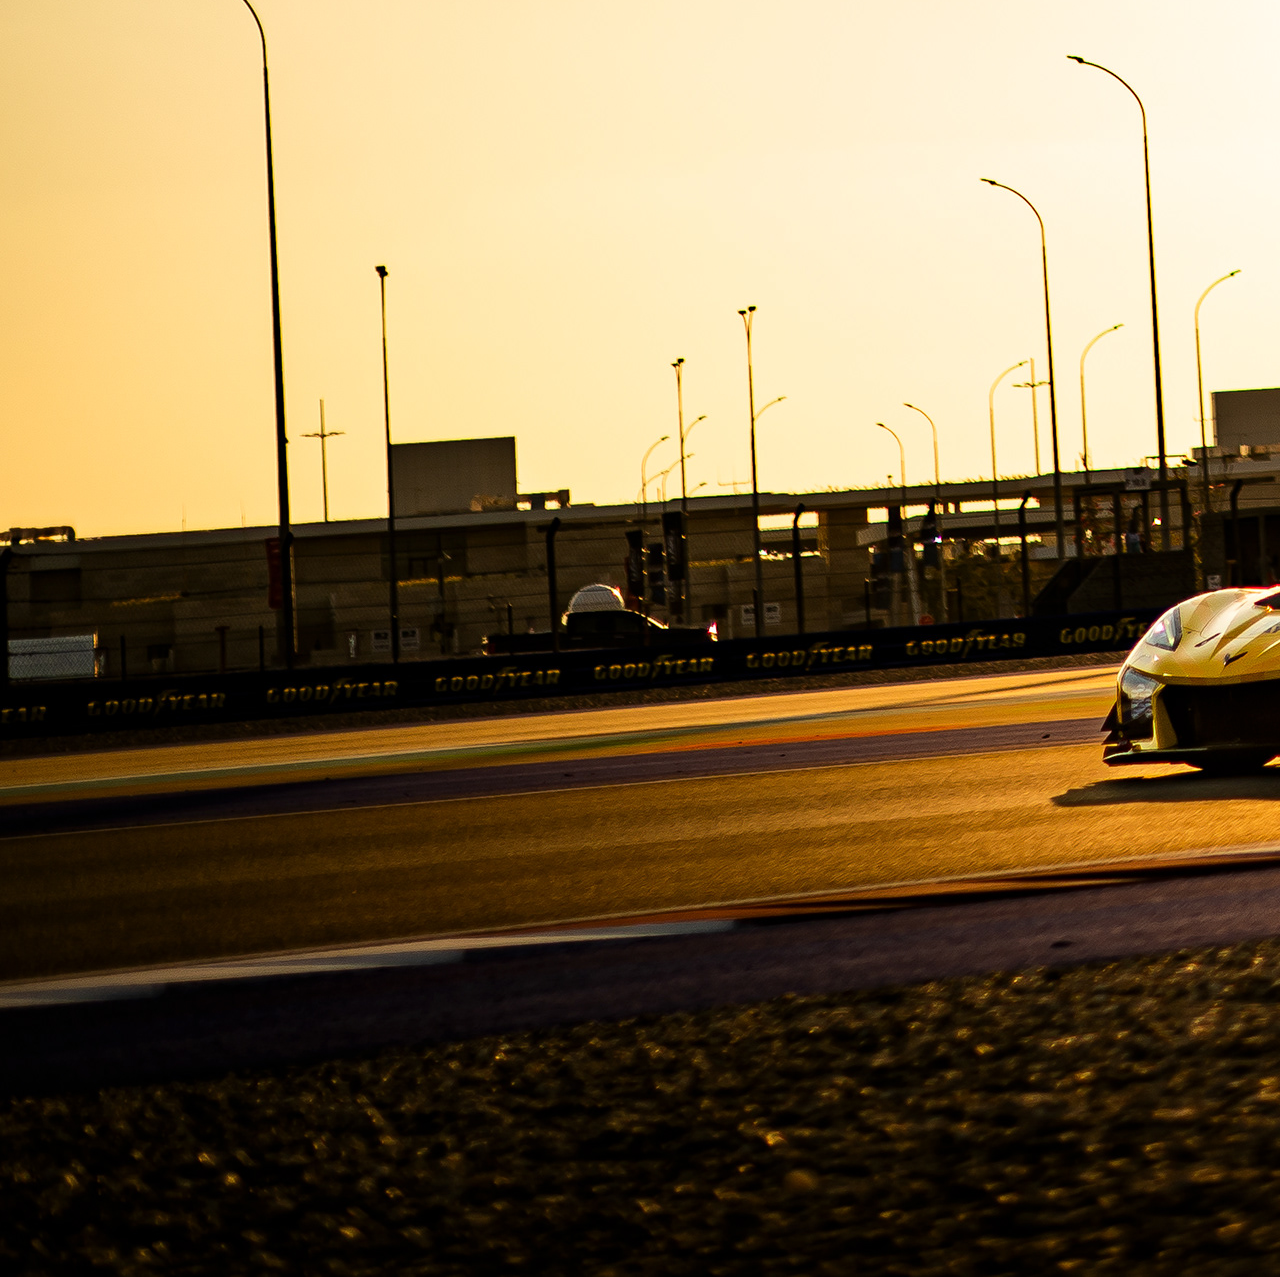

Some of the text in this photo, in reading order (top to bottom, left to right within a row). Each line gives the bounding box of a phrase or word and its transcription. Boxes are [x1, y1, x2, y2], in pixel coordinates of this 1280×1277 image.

[905, 629, 1027, 659] GOODYEAR
[1058, 617, 1149, 645] GOODYE
[593, 654, 714, 680] GOODYEAR
[745, 641, 874, 671] GOODYEAR
[266, 677, 399, 705] GOODYEAR
[434, 666, 561, 696] GOODYEAR
[87, 689, 227, 719] GOODYEAR
